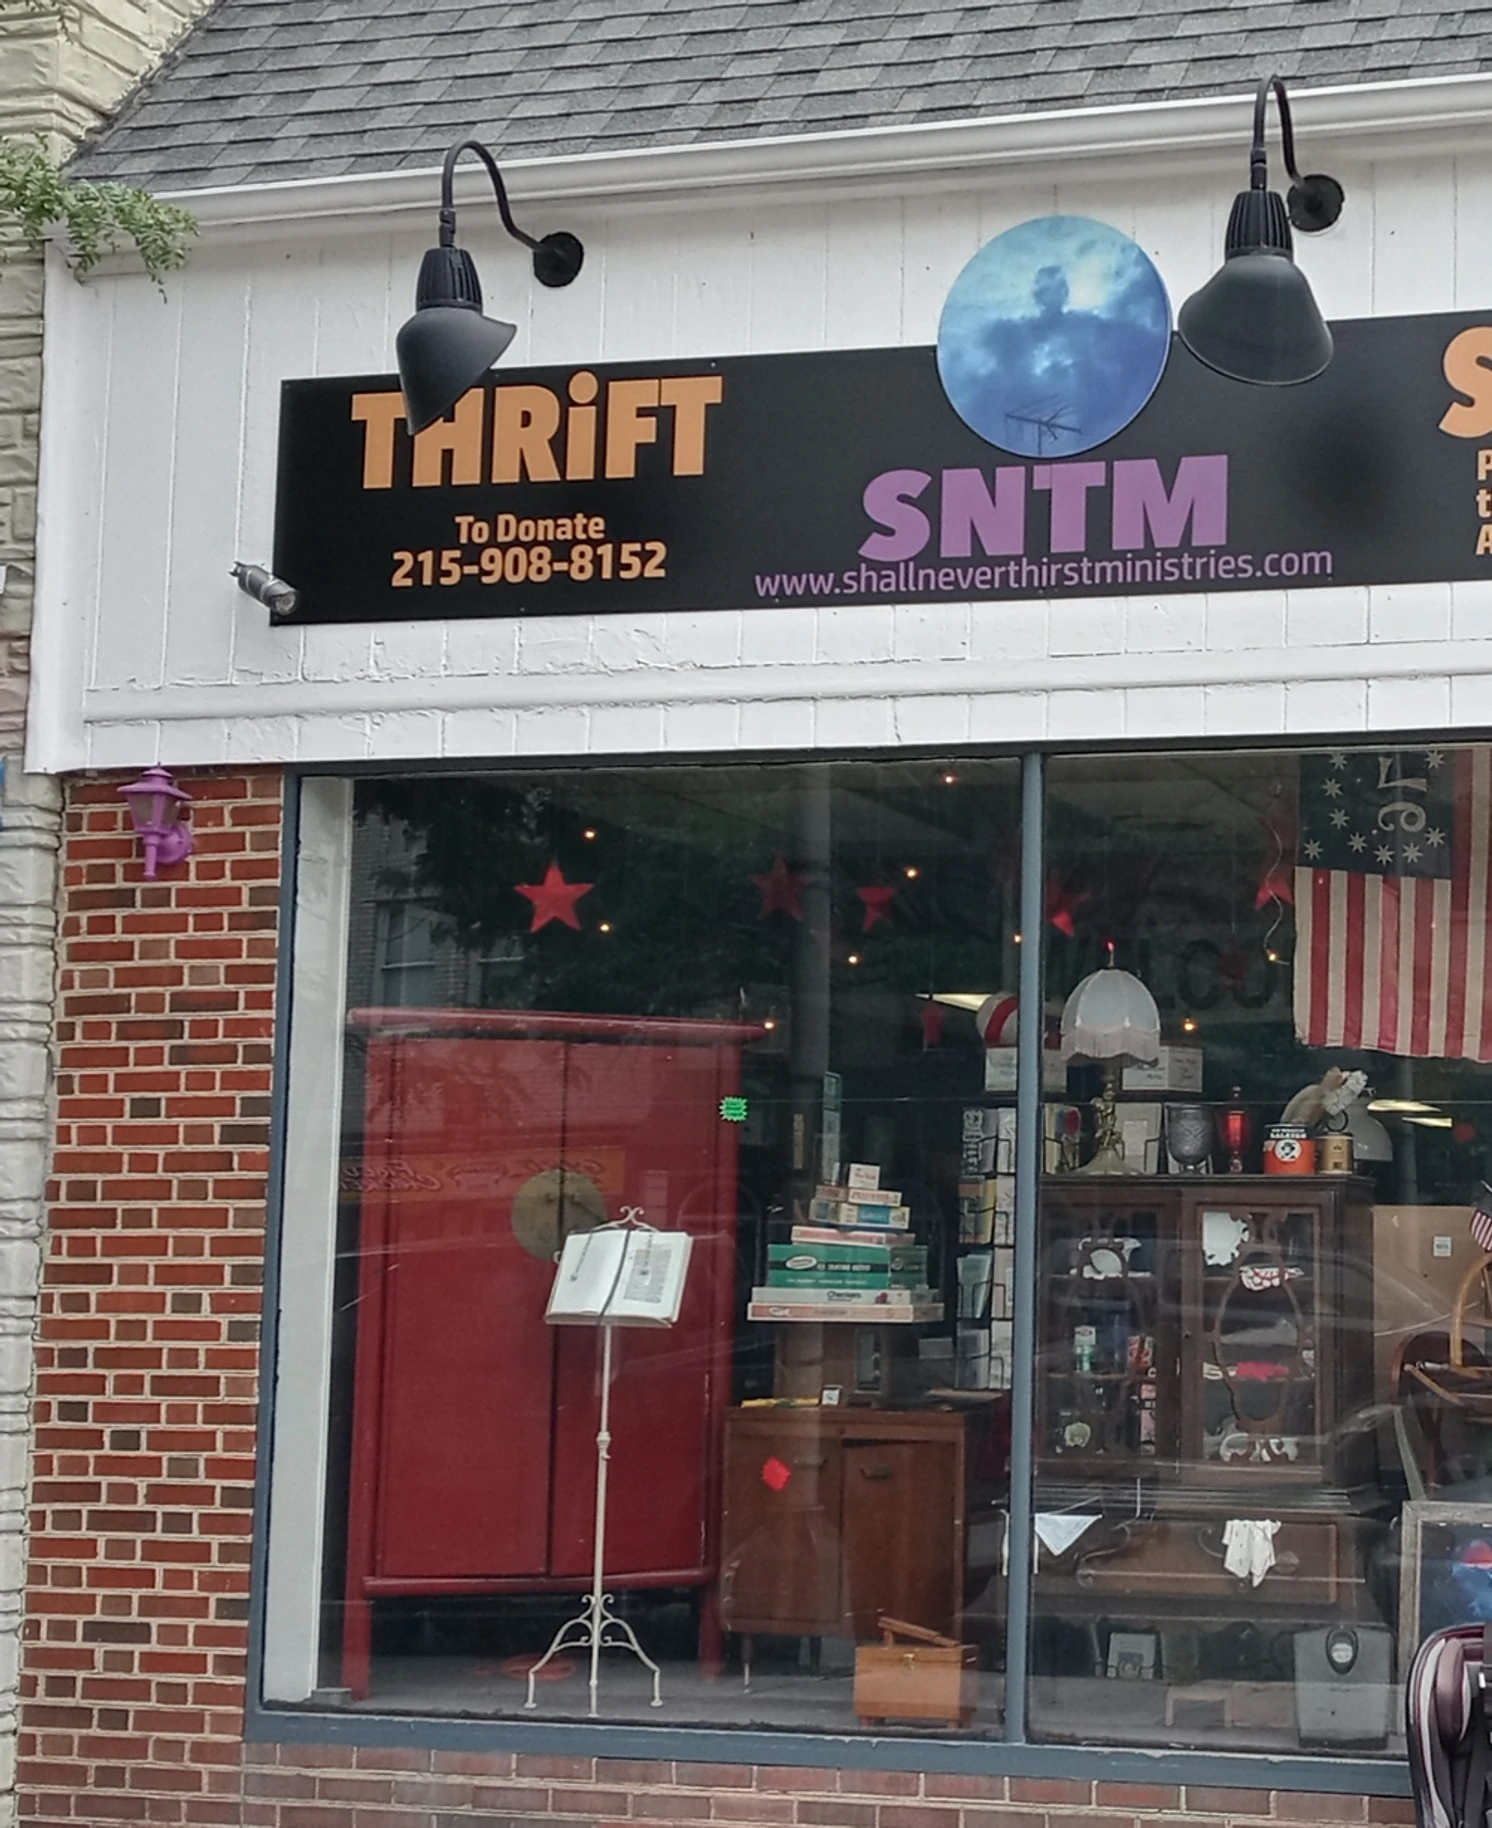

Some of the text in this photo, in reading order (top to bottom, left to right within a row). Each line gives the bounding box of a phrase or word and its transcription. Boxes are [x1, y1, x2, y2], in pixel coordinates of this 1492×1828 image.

[456, 512, 606, 545] To Donate
[857, 454, 1228, 563] SNTM
[392, 541, 667, 587] 215-908-8152
[754, 549, 1335, 598] www.shallneverthirstministries.com
